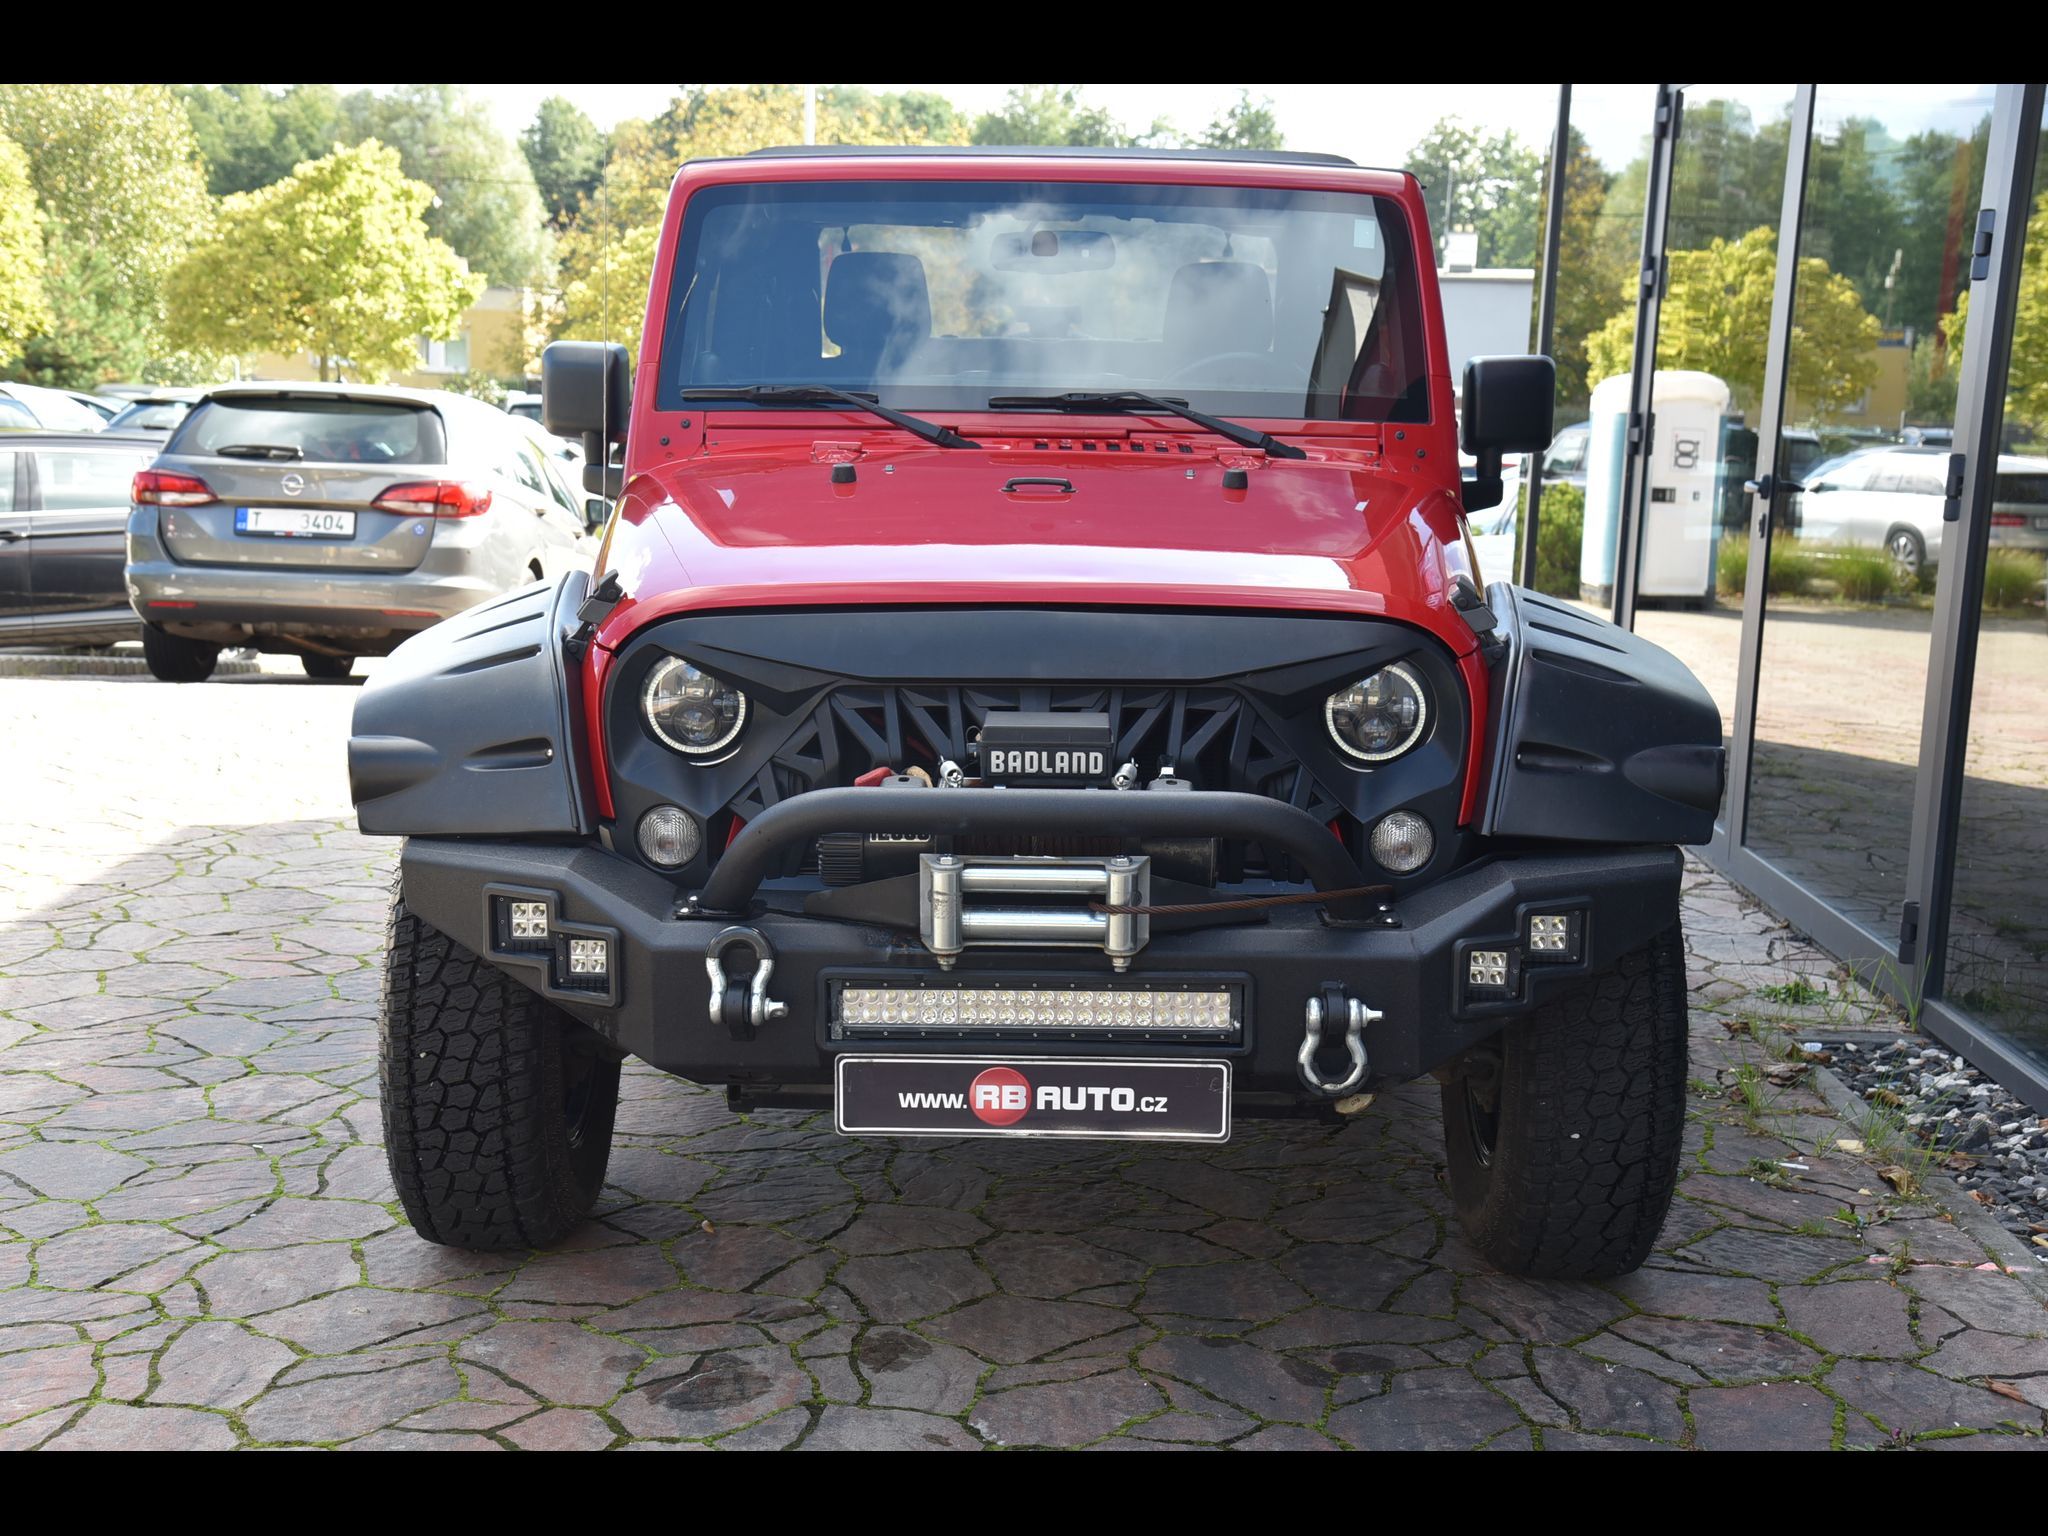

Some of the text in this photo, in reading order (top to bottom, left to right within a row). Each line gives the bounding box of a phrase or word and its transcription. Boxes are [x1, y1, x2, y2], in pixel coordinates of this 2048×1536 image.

[253, 511, 262, 528] T
[300, 513, 344, 531] 3404
[990, 750, 1104, 775] BADLAND
